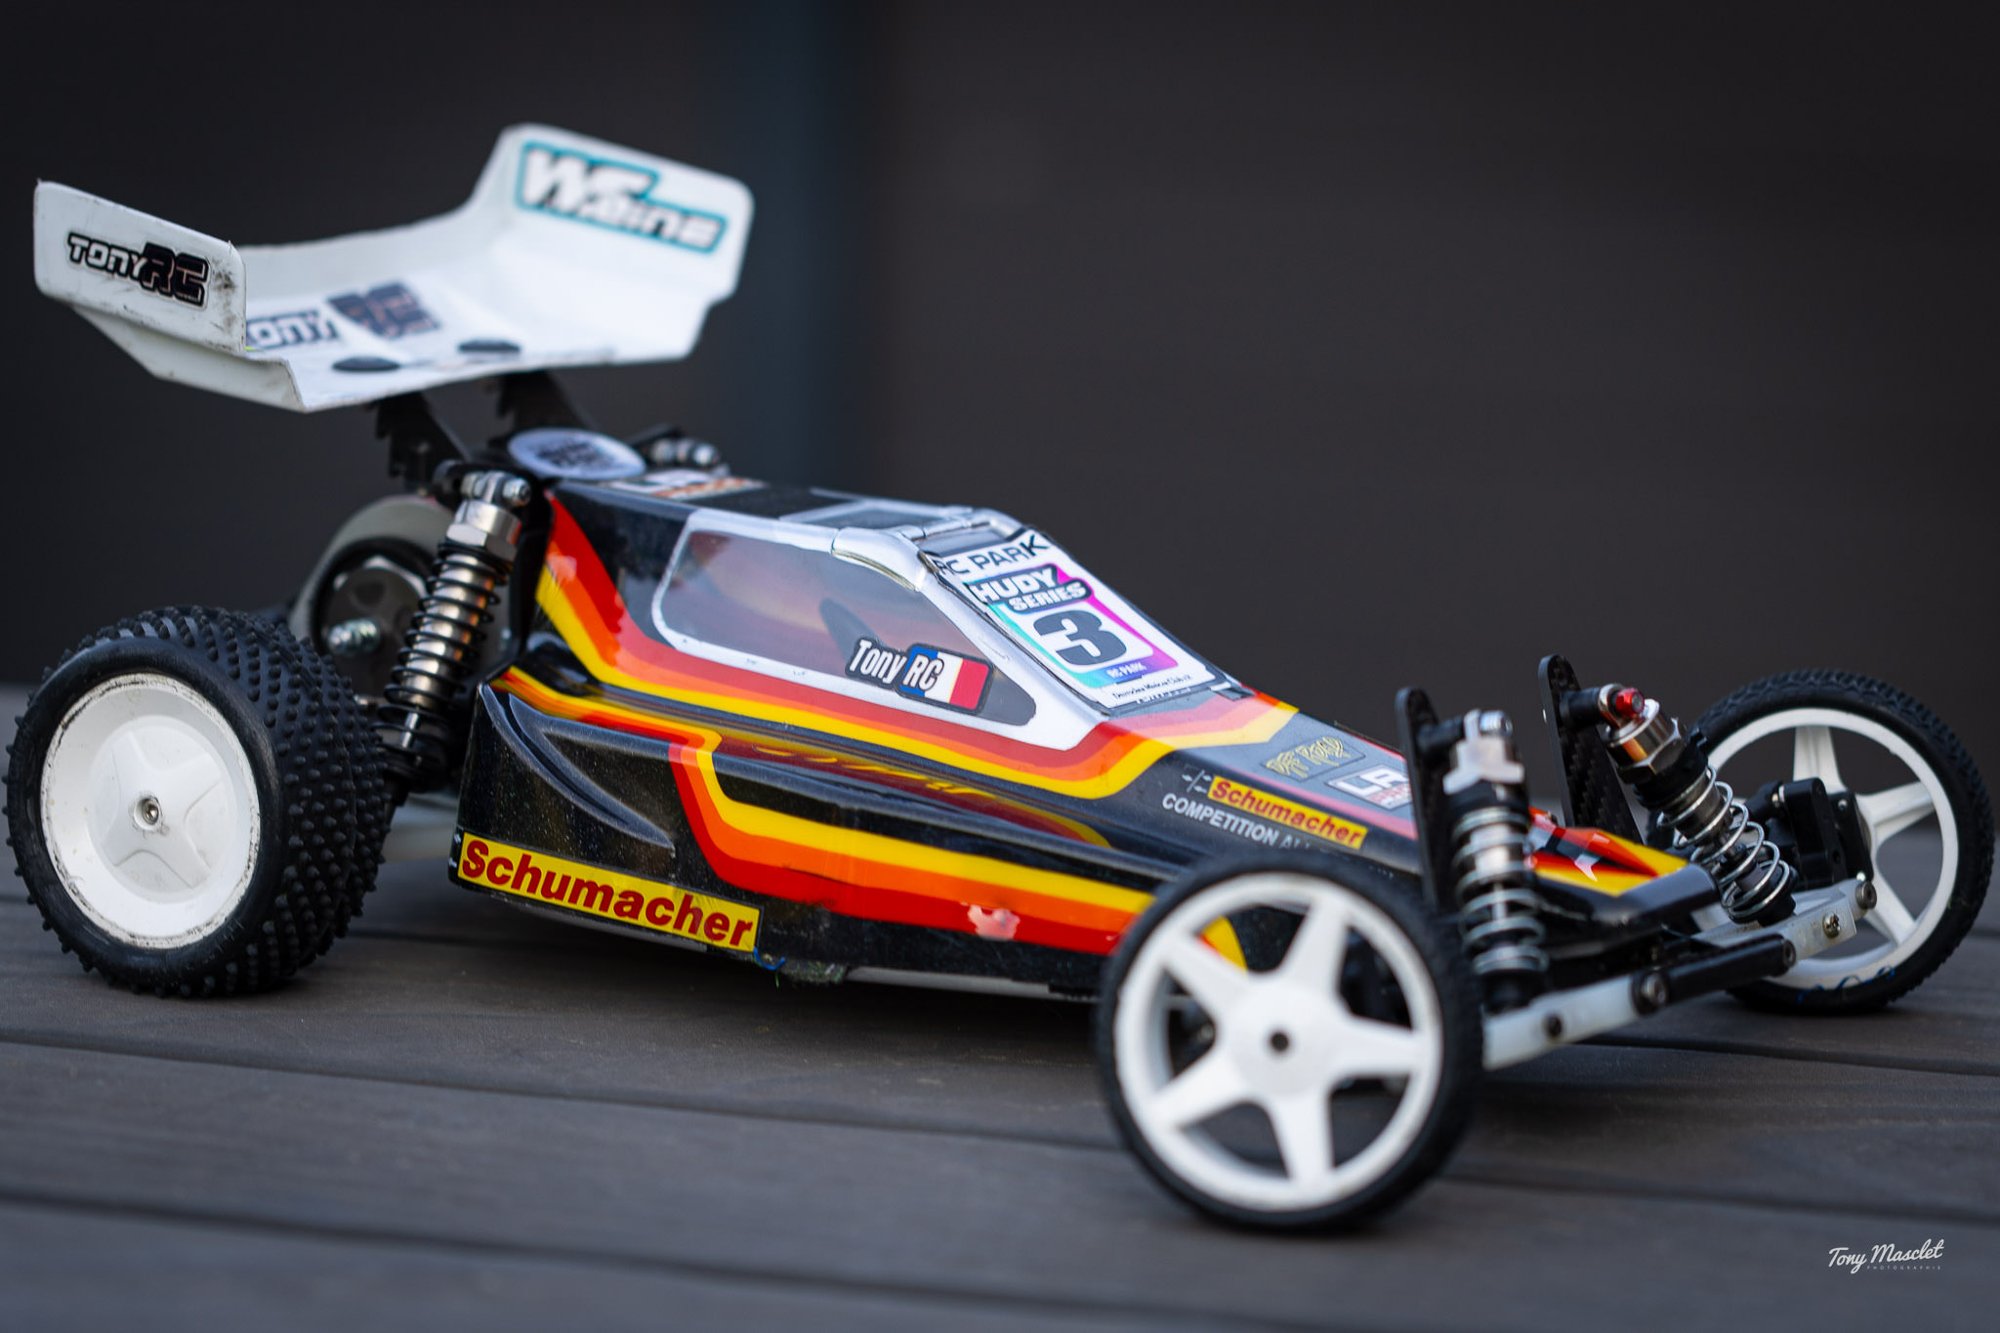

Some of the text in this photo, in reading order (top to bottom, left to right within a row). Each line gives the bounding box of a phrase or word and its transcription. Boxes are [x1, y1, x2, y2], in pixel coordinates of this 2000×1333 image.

[968, 534, 1050, 569] PARK
[970, 567, 1057, 603] HUDY
[1009, 581, 1087, 611] SERIES
[1033, 610, 1127, 666] 3
[850, 639, 945, 691] Tony RC
[1161, 793, 1279, 847] COMPETITION
[1211, 779, 1363, 847] Schumacher
[462, 839, 753, 946] Schumacher
